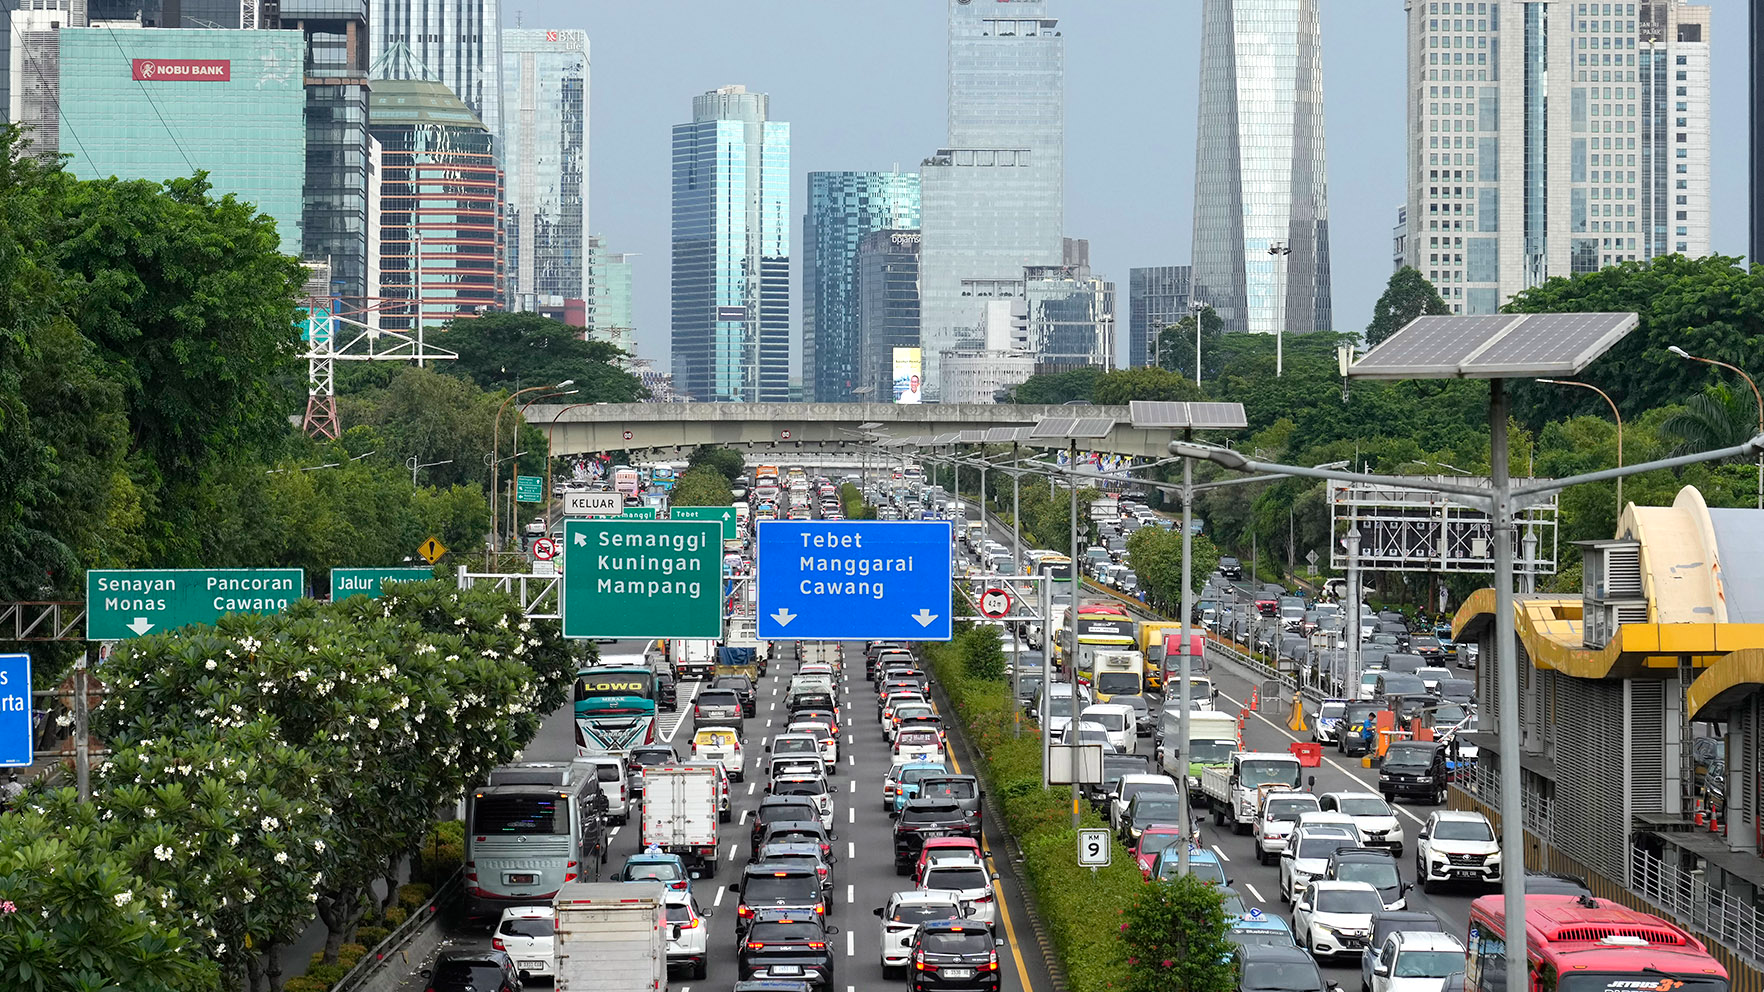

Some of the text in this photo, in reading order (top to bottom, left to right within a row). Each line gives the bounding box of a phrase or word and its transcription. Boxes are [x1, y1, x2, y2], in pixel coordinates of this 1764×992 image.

[558, 31, 580, 41] BNI
[566, 42, 580, 50] Life
[157, 65, 224, 75] NOBU BANK
[571, 499, 615, 509] KELUAR
[598, 531, 706, 551] Semanggi
[800, 532, 862, 548] Tebet
[598, 555, 701, 575] Kuningan
[800, 556, 913, 576] Manggarai
[98, 577, 176, 594] Senayan
[206, 577, 293, 590] Pancoran
[338, 575, 374, 590] Jalur
[597, 579, 701, 598] Mampang
[800, 580, 884, 599] Cawang
[105, 597, 166, 611] Monas
[213, 597, 288, 610] Cawang
[585, 683, 642, 691] LOWO
[0, 694, 24, 711] rta
[1088, 843, 1100, 857] 9
